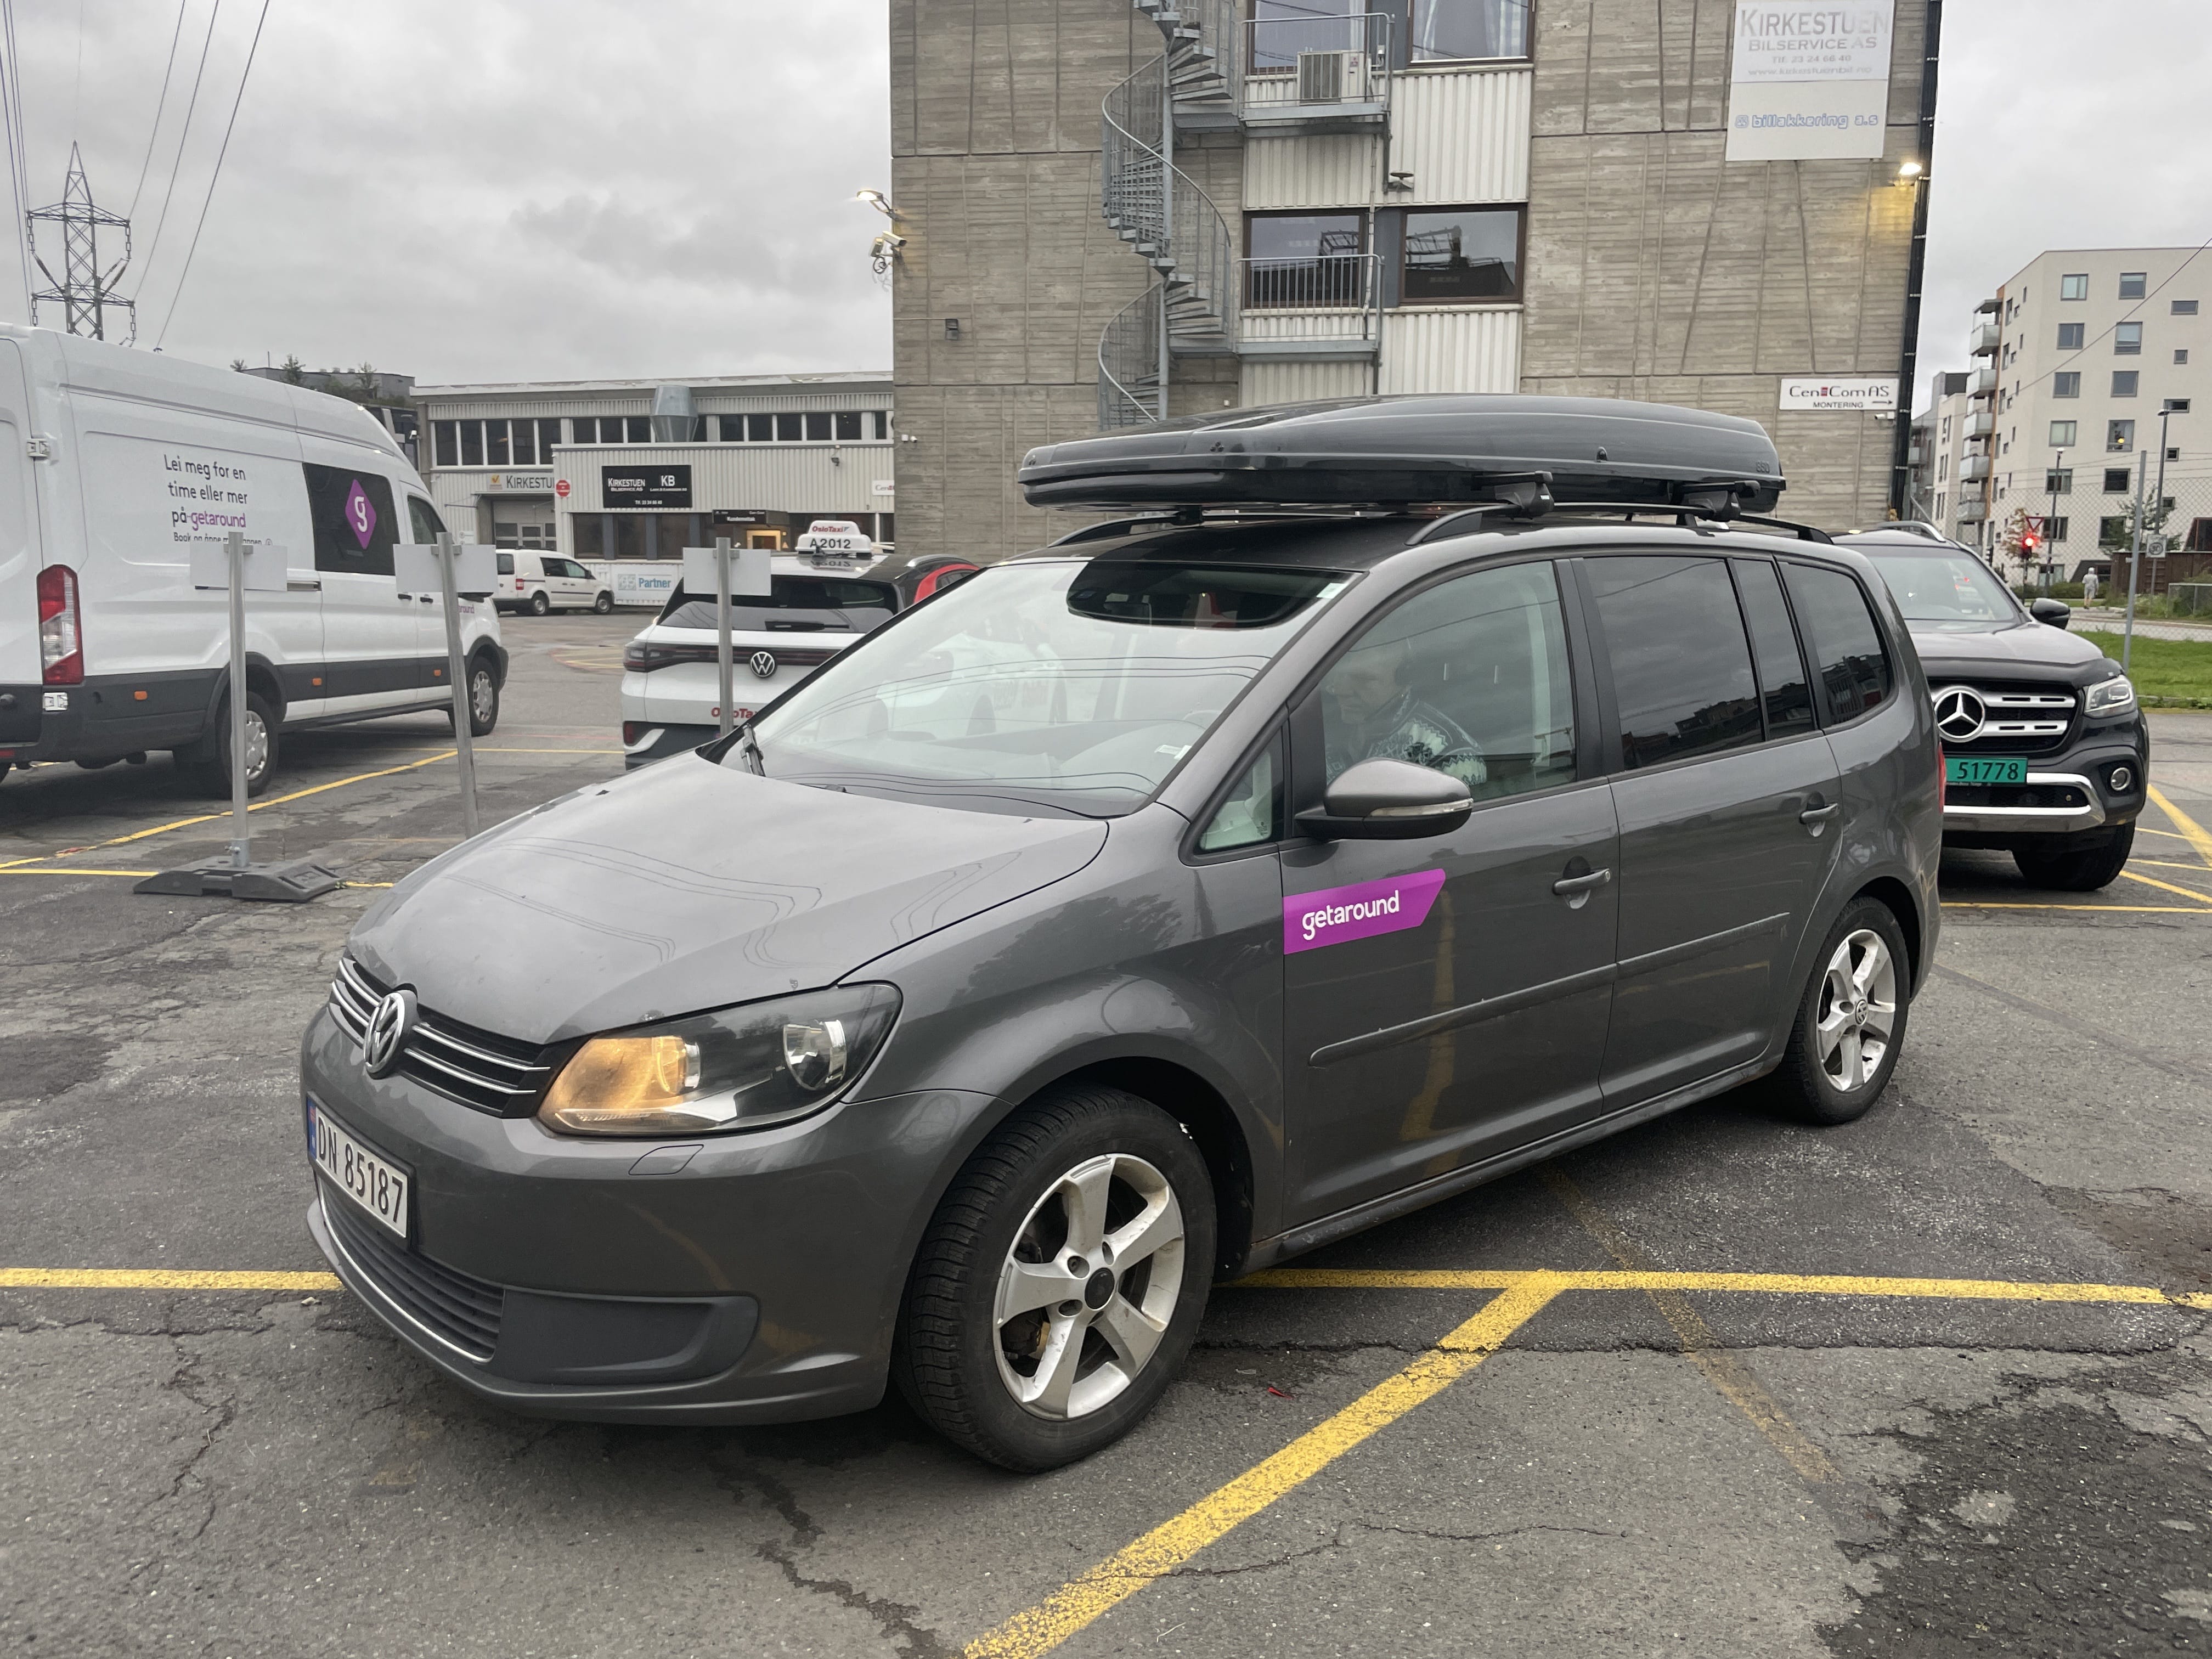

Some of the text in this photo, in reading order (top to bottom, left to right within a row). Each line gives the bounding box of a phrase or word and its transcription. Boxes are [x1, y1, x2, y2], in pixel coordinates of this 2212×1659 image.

[1741, 9, 1888, 37] KIRKESTUEN
[1748, 37, 1877, 52] BILSERVICE AS
[1752, 114, 1878, 129] billakkering a.s
[164, 454, 246, 480] Lei meg for en
[506, 475, 554, 488] KIRKESTU
[608, 478, 645, 487] KIRKESTUEN
[661, 475, 675, 487] KB
[168, 480, 247, 504] time eller mer
[172, 506, 246, 531] på getaround
[810, 538, 851, 549] A2012
[639, 578, 672, 588] Partner
[1957, 762, 2018, 780] 51778
[1302, 889, 1400, 940] getaround
[318, 1116, 403, 1223] DN 85187
